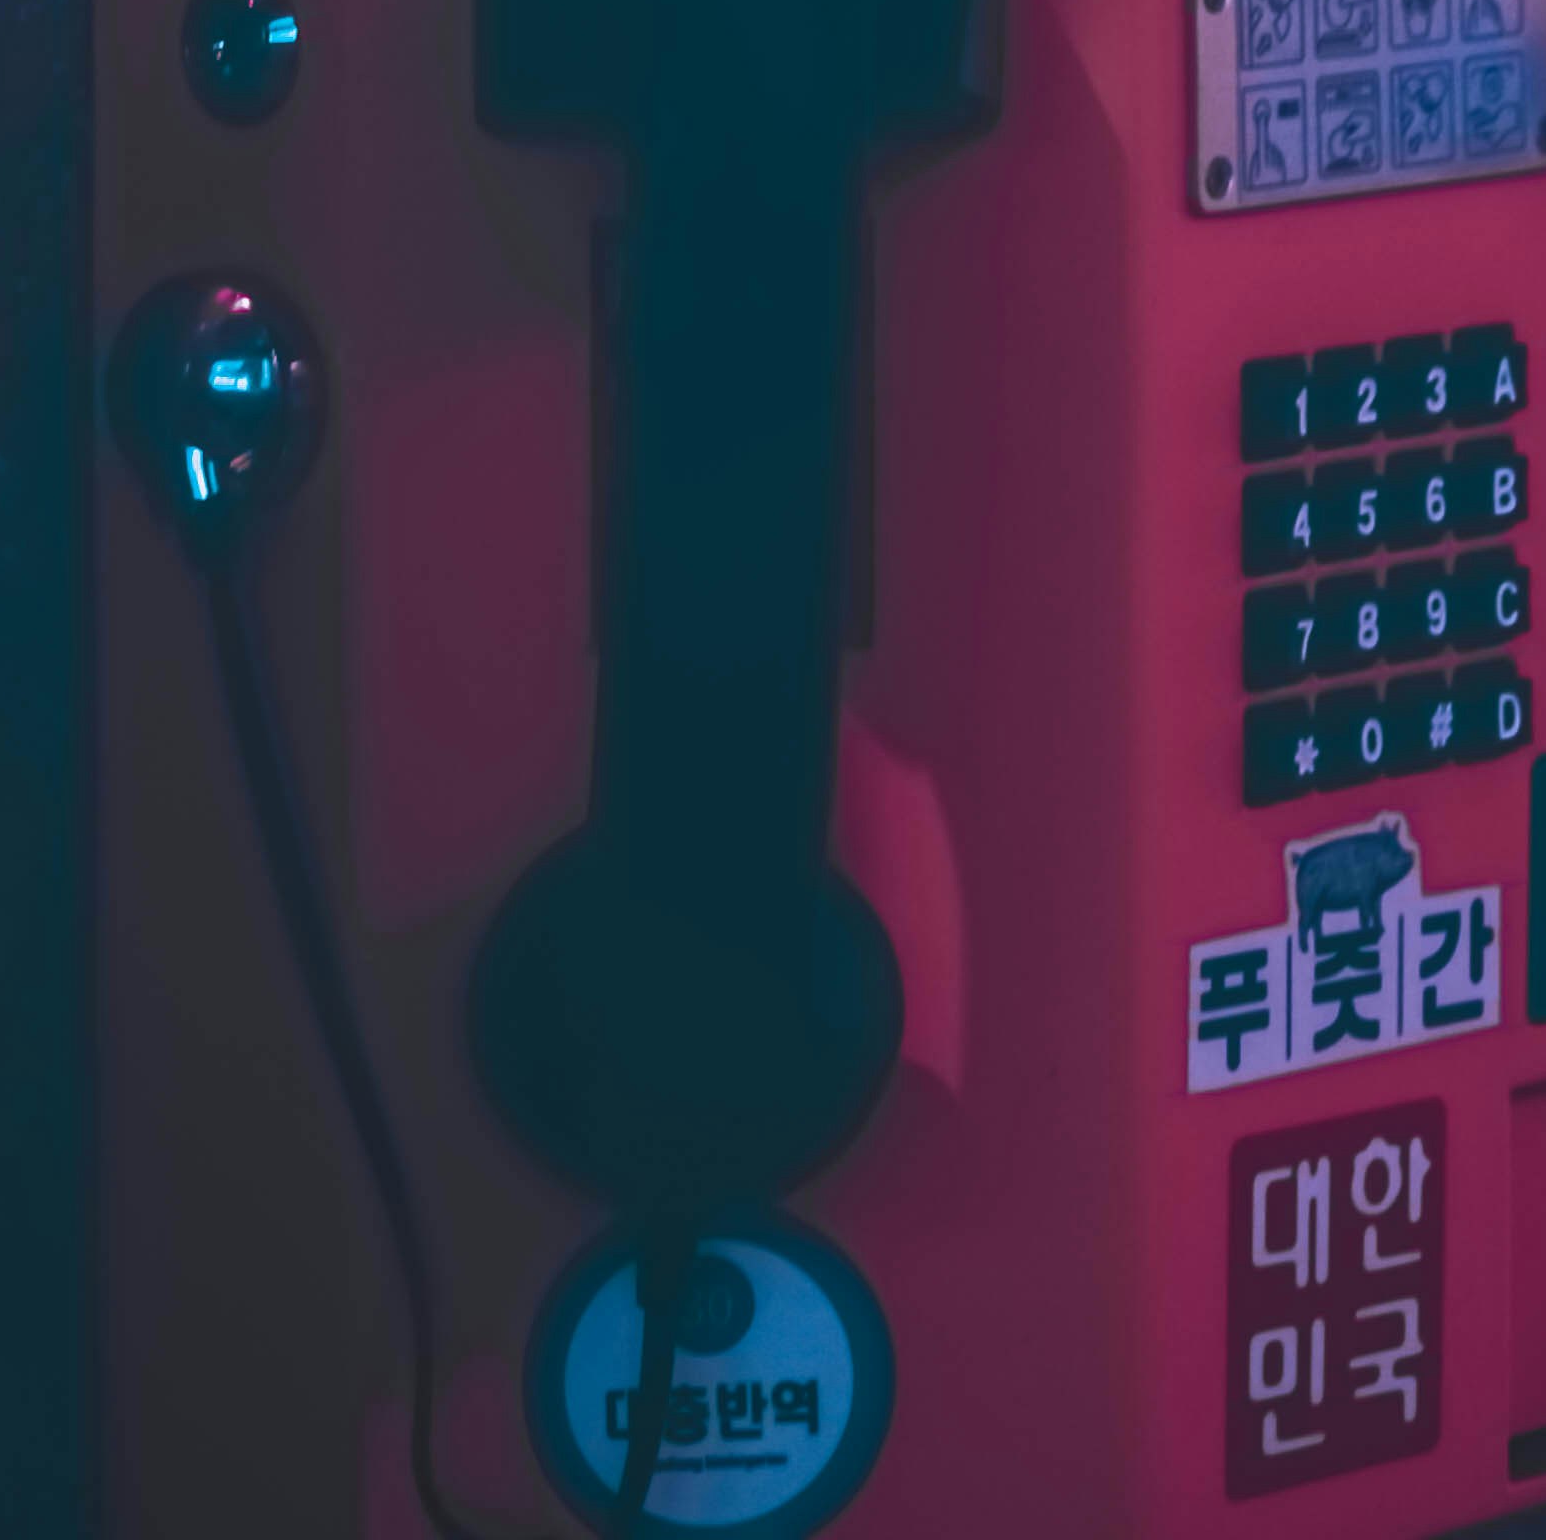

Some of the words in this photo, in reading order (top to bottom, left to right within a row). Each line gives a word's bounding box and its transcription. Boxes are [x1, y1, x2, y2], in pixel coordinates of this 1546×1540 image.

[1295, 387, 1309, 437] 1
[1357, 377, 1378, 424] 2
[1425, 365, 1448, 414] 3
[1493, 356, 1517, 405] A
[1292, 501, 1311, 549] 4
[1357, 489, 1378, 536] 5
[1425, 476, 1446, 524] 6
[1492, 467, 1517, 516] B
[1297, 618, 1315, 662] 7
[1357, 602, 1379, 651] 8
[1426, 589, 1447, 636] 9
[1495, 580, 1519, 628] C
[1361, 717, 1384, 764] 0
[1497, 691, 1521, 741] D
[1251, 1136, 1431, 1289] 대한
[1248, 1296, 1424, 1457] 민국
